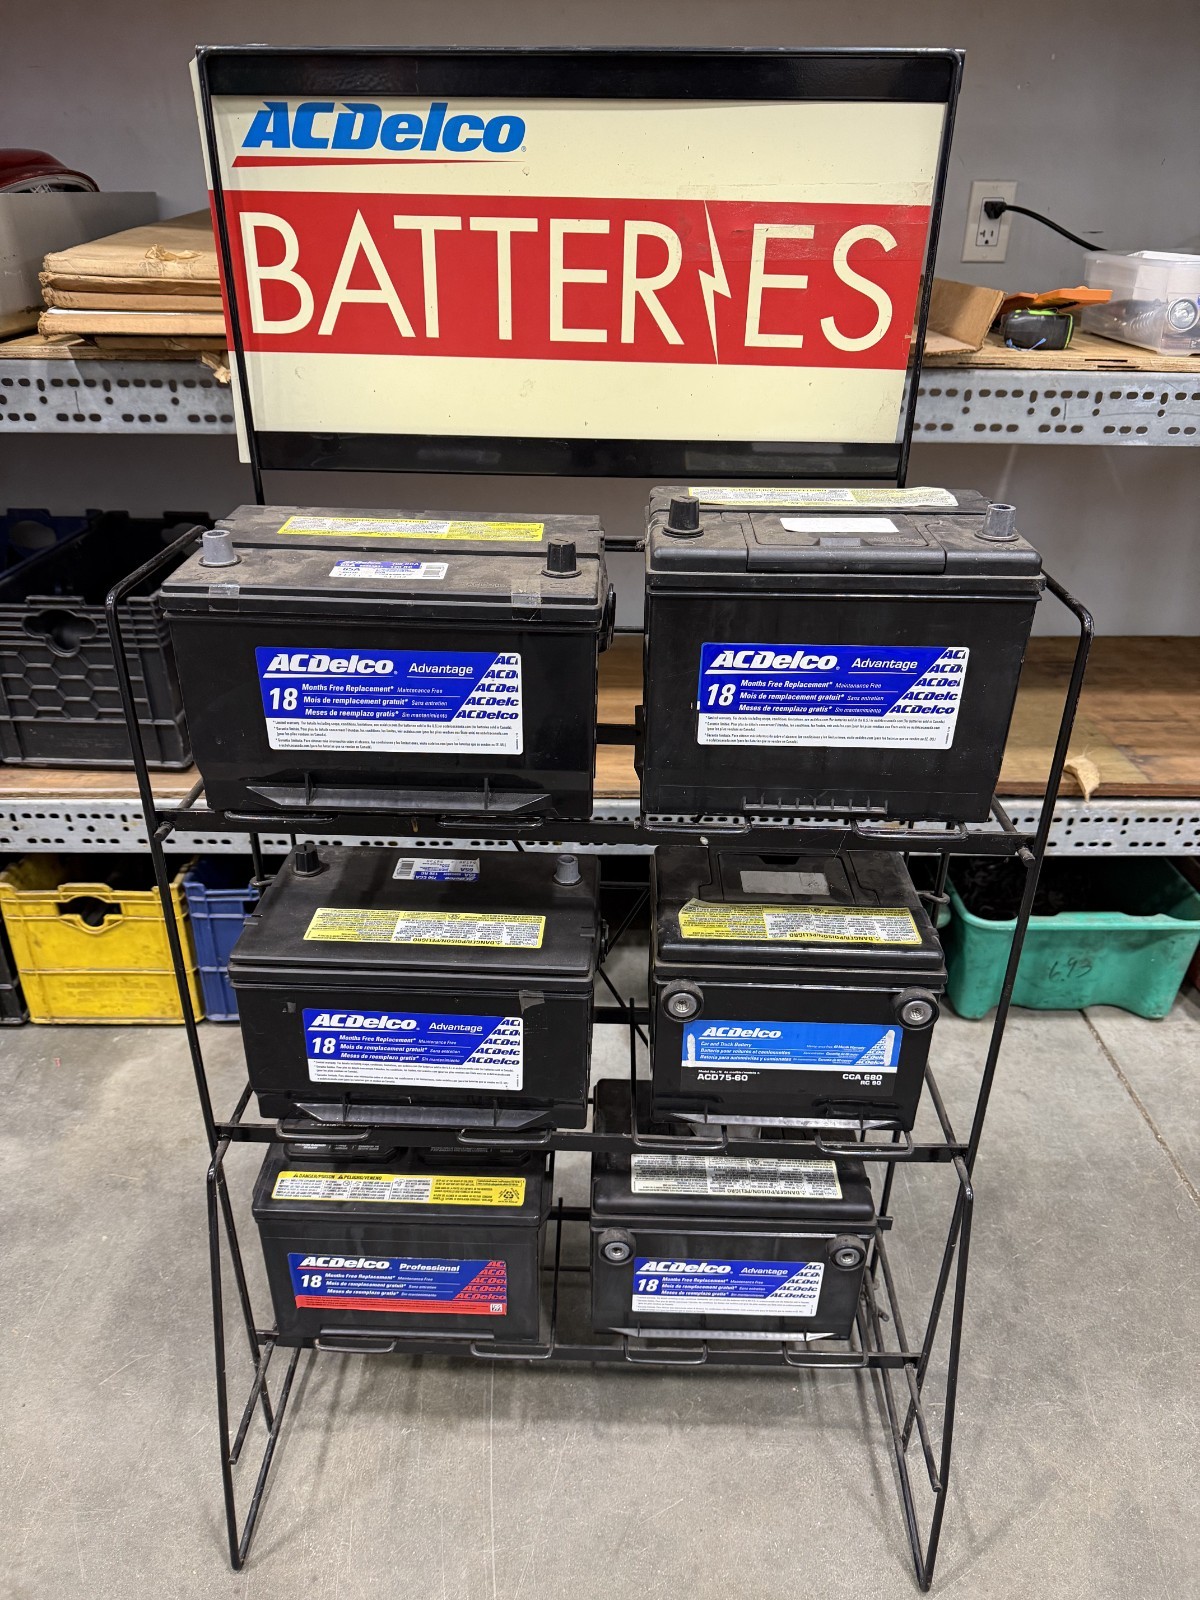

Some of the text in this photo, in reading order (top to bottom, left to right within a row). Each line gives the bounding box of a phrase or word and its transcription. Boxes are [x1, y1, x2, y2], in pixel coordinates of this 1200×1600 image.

[242, 101, 526, 153] ACDelco
[267, 654, 393, 674] ACDelco
[710, 651, 837, 669] ACDelco
[852, 658, 918, 671] Advantage
[409, 663, 473, 675] Advantage
[270, 688, 298, 710] 18
[708, 684, 736, 706] 18
[769, 693, 816, 702] remplacement
[340, 709, 374, 718] reemplazo
[456, 710, 518, 719] ACDelco
[773, 705, 807, 713] reemplazo
[889, 705, 955, 714] ACDelco
[311, 1014, 417, 1030] ACDelco
[429, 1023, 482, 1032] Advantage
[702, 1027, 781, 1038] ACDelco
[312, 1038, 336, 1054] 18
[467, 1057, 519, 1065] ACDelco
[300, 1257, 389, 1269] ACDelco
[400, 1263, 460, 1272] Professional
[640, 1261, 731, 1273] ACDelco
[301, 1275, 322, 1288] 18
[638, 1279, 659, 1291] 18
